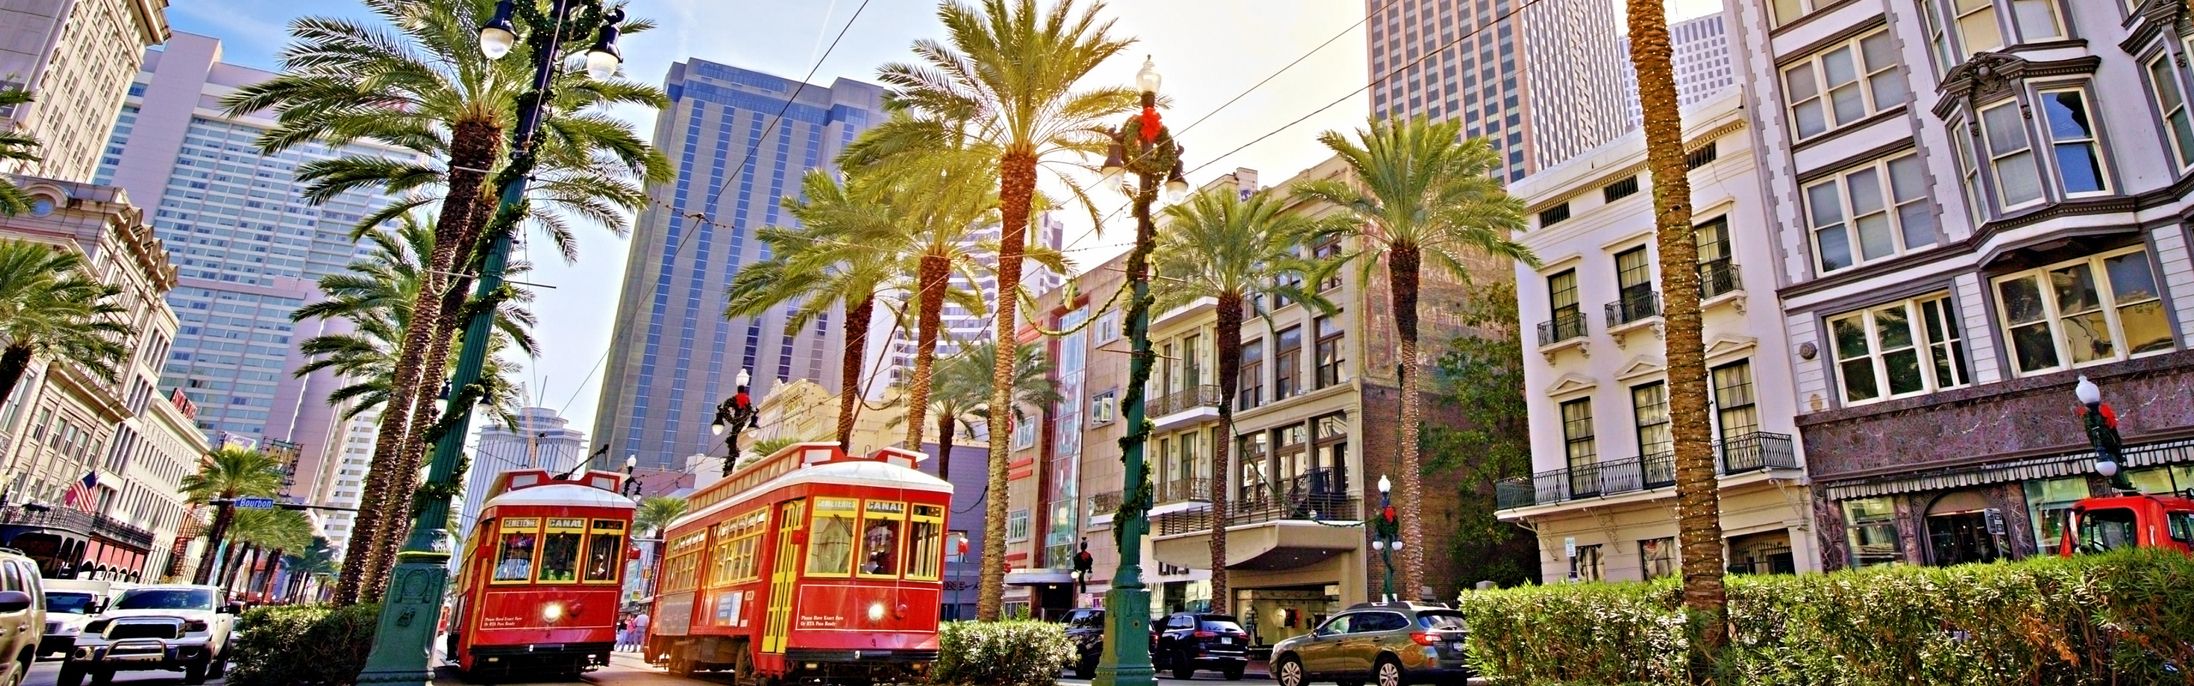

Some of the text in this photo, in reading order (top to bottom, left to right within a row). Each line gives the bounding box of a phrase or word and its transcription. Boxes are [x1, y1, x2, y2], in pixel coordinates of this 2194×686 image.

[240, 498, 272, 508] Bourbon
[866, 501, 904, 511] CANAL
[550, 519, 584, 528] CANAL
